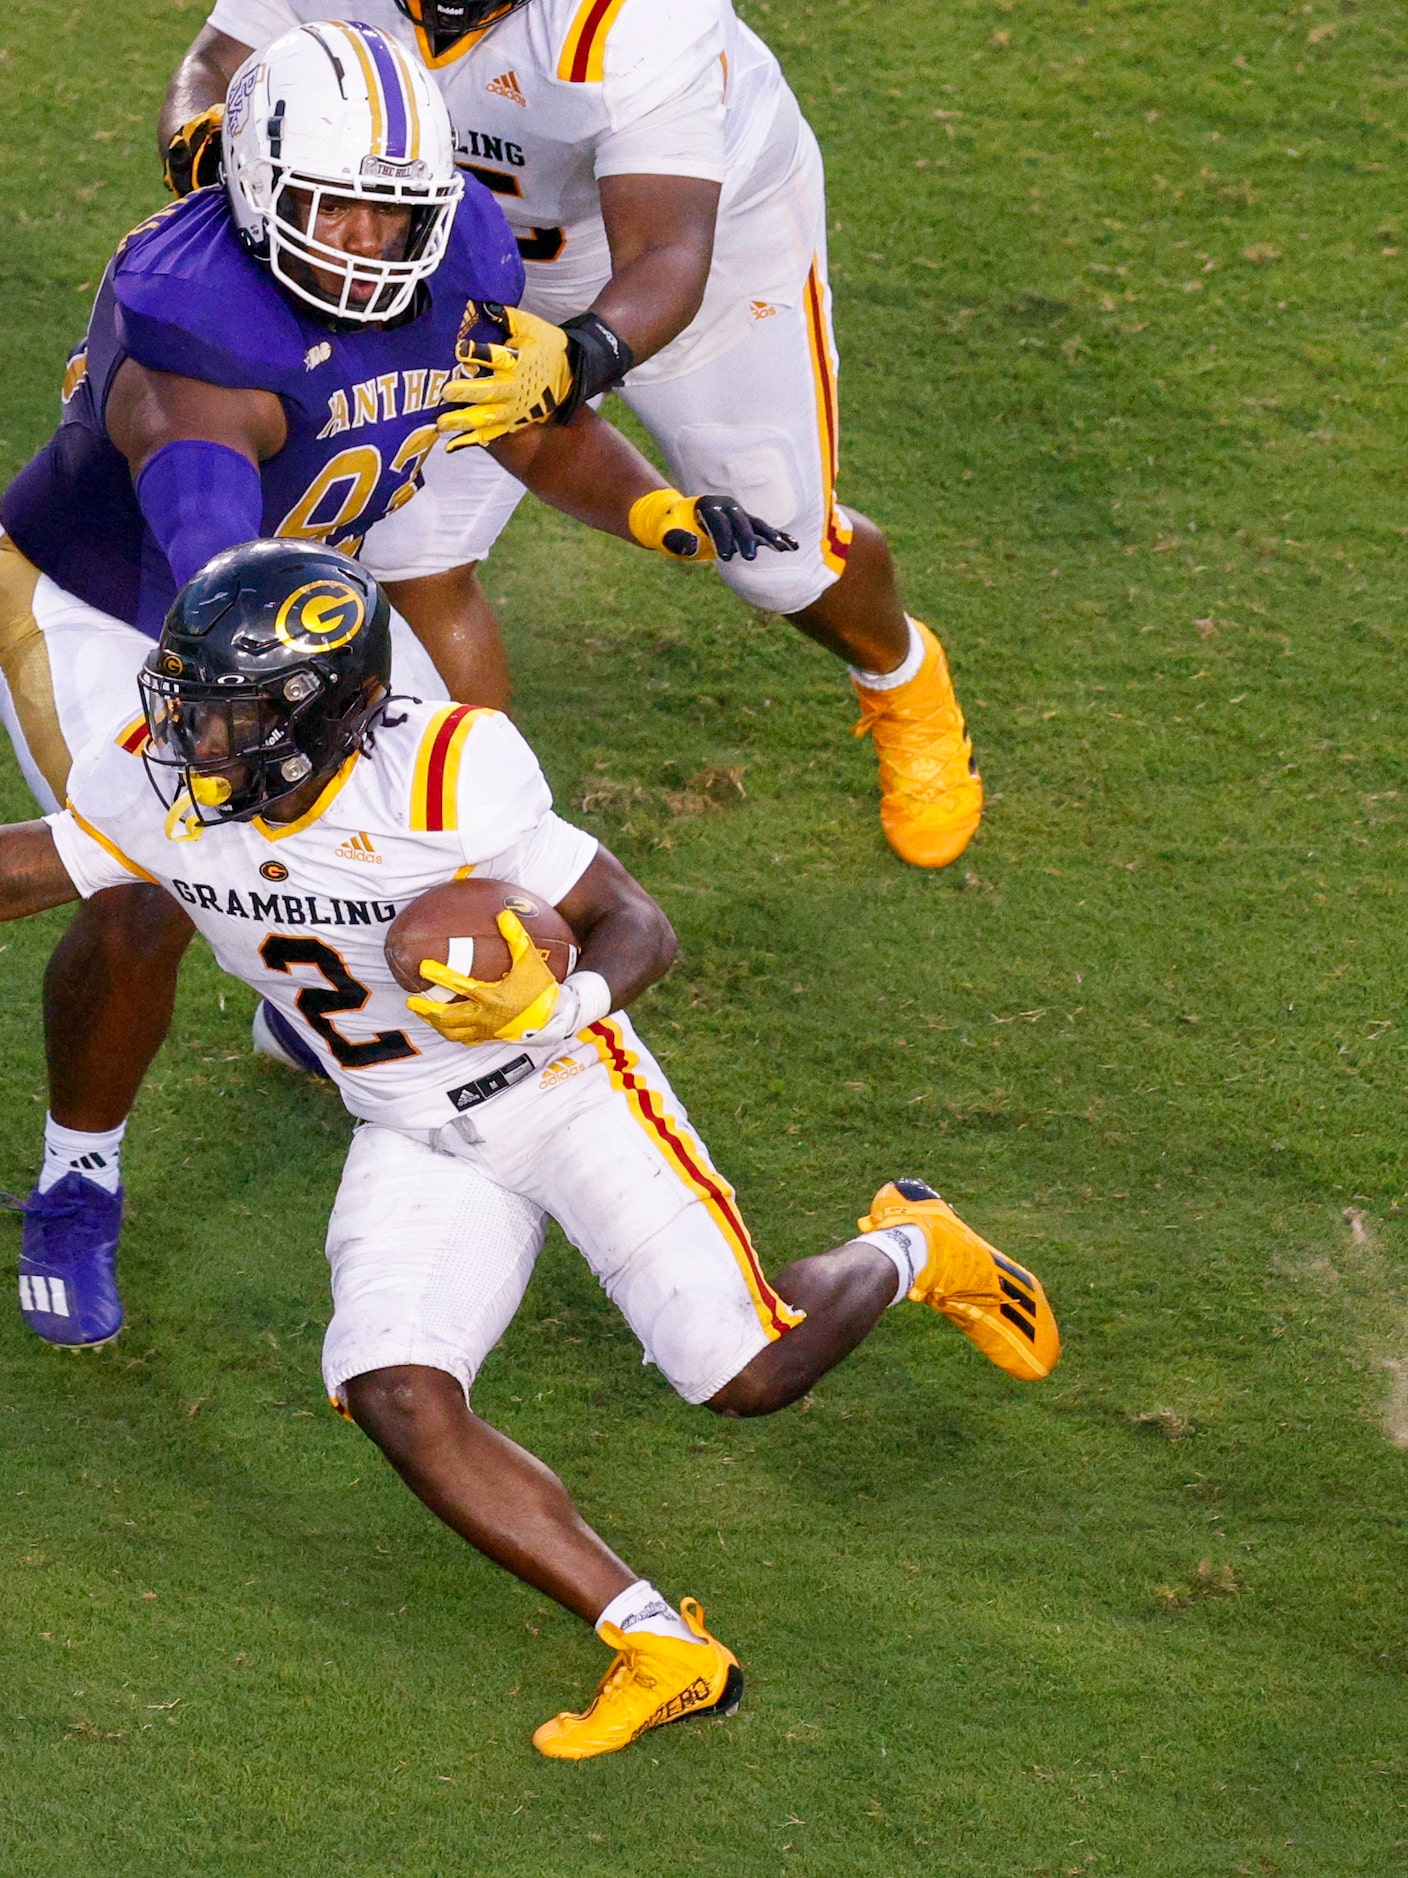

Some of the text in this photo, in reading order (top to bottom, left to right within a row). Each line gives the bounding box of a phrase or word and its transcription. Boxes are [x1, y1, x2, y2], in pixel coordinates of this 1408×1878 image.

[335, 847, 383, 865] adidas
[172, 878, 397, 926] GRAMBLING
[257, 932, 421, 1071] 2
[538, 1063, 586, 1091] adidas
